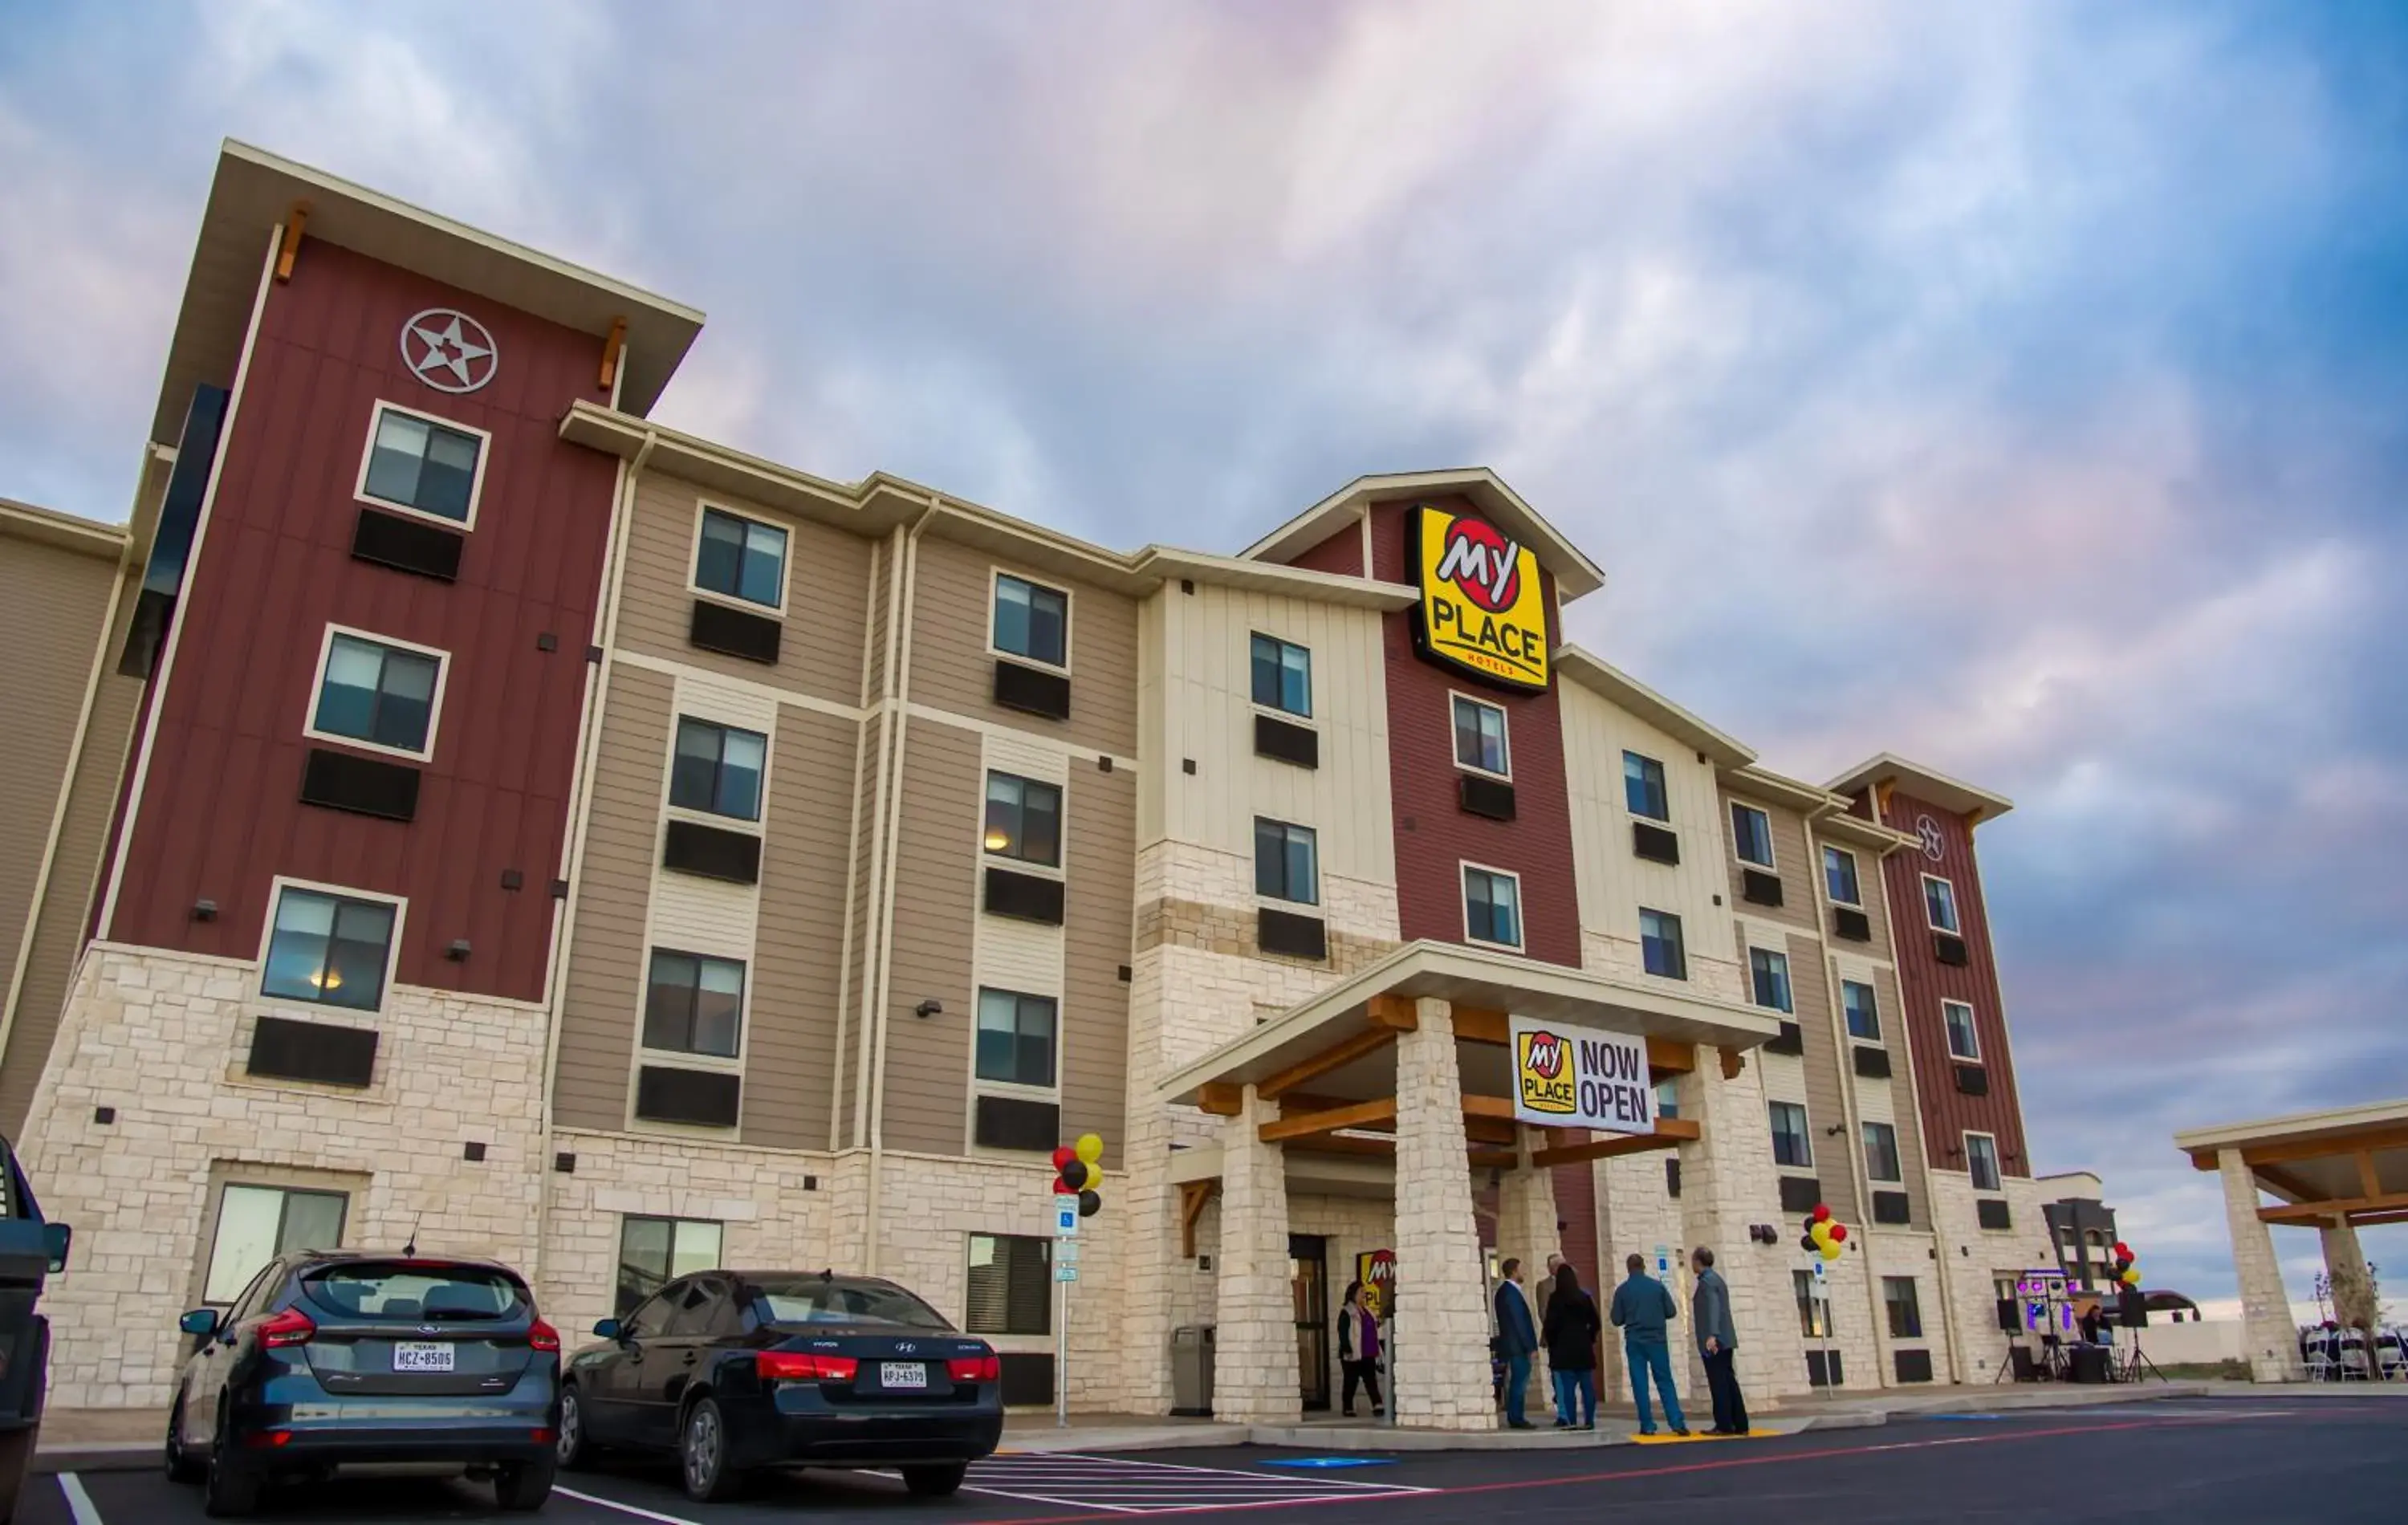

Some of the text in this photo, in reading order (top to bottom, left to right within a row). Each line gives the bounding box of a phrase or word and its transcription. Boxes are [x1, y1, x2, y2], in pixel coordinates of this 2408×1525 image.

[1432, 596, 1542, 665] PLACE
[1467, 654, 1514, 675] HOTELS
[1580, 1039, 1639, 1082] NOW
[1525, 1078, 1572, 1100] PLACE
[1580, 1080, 1648, 1124] OPEN
